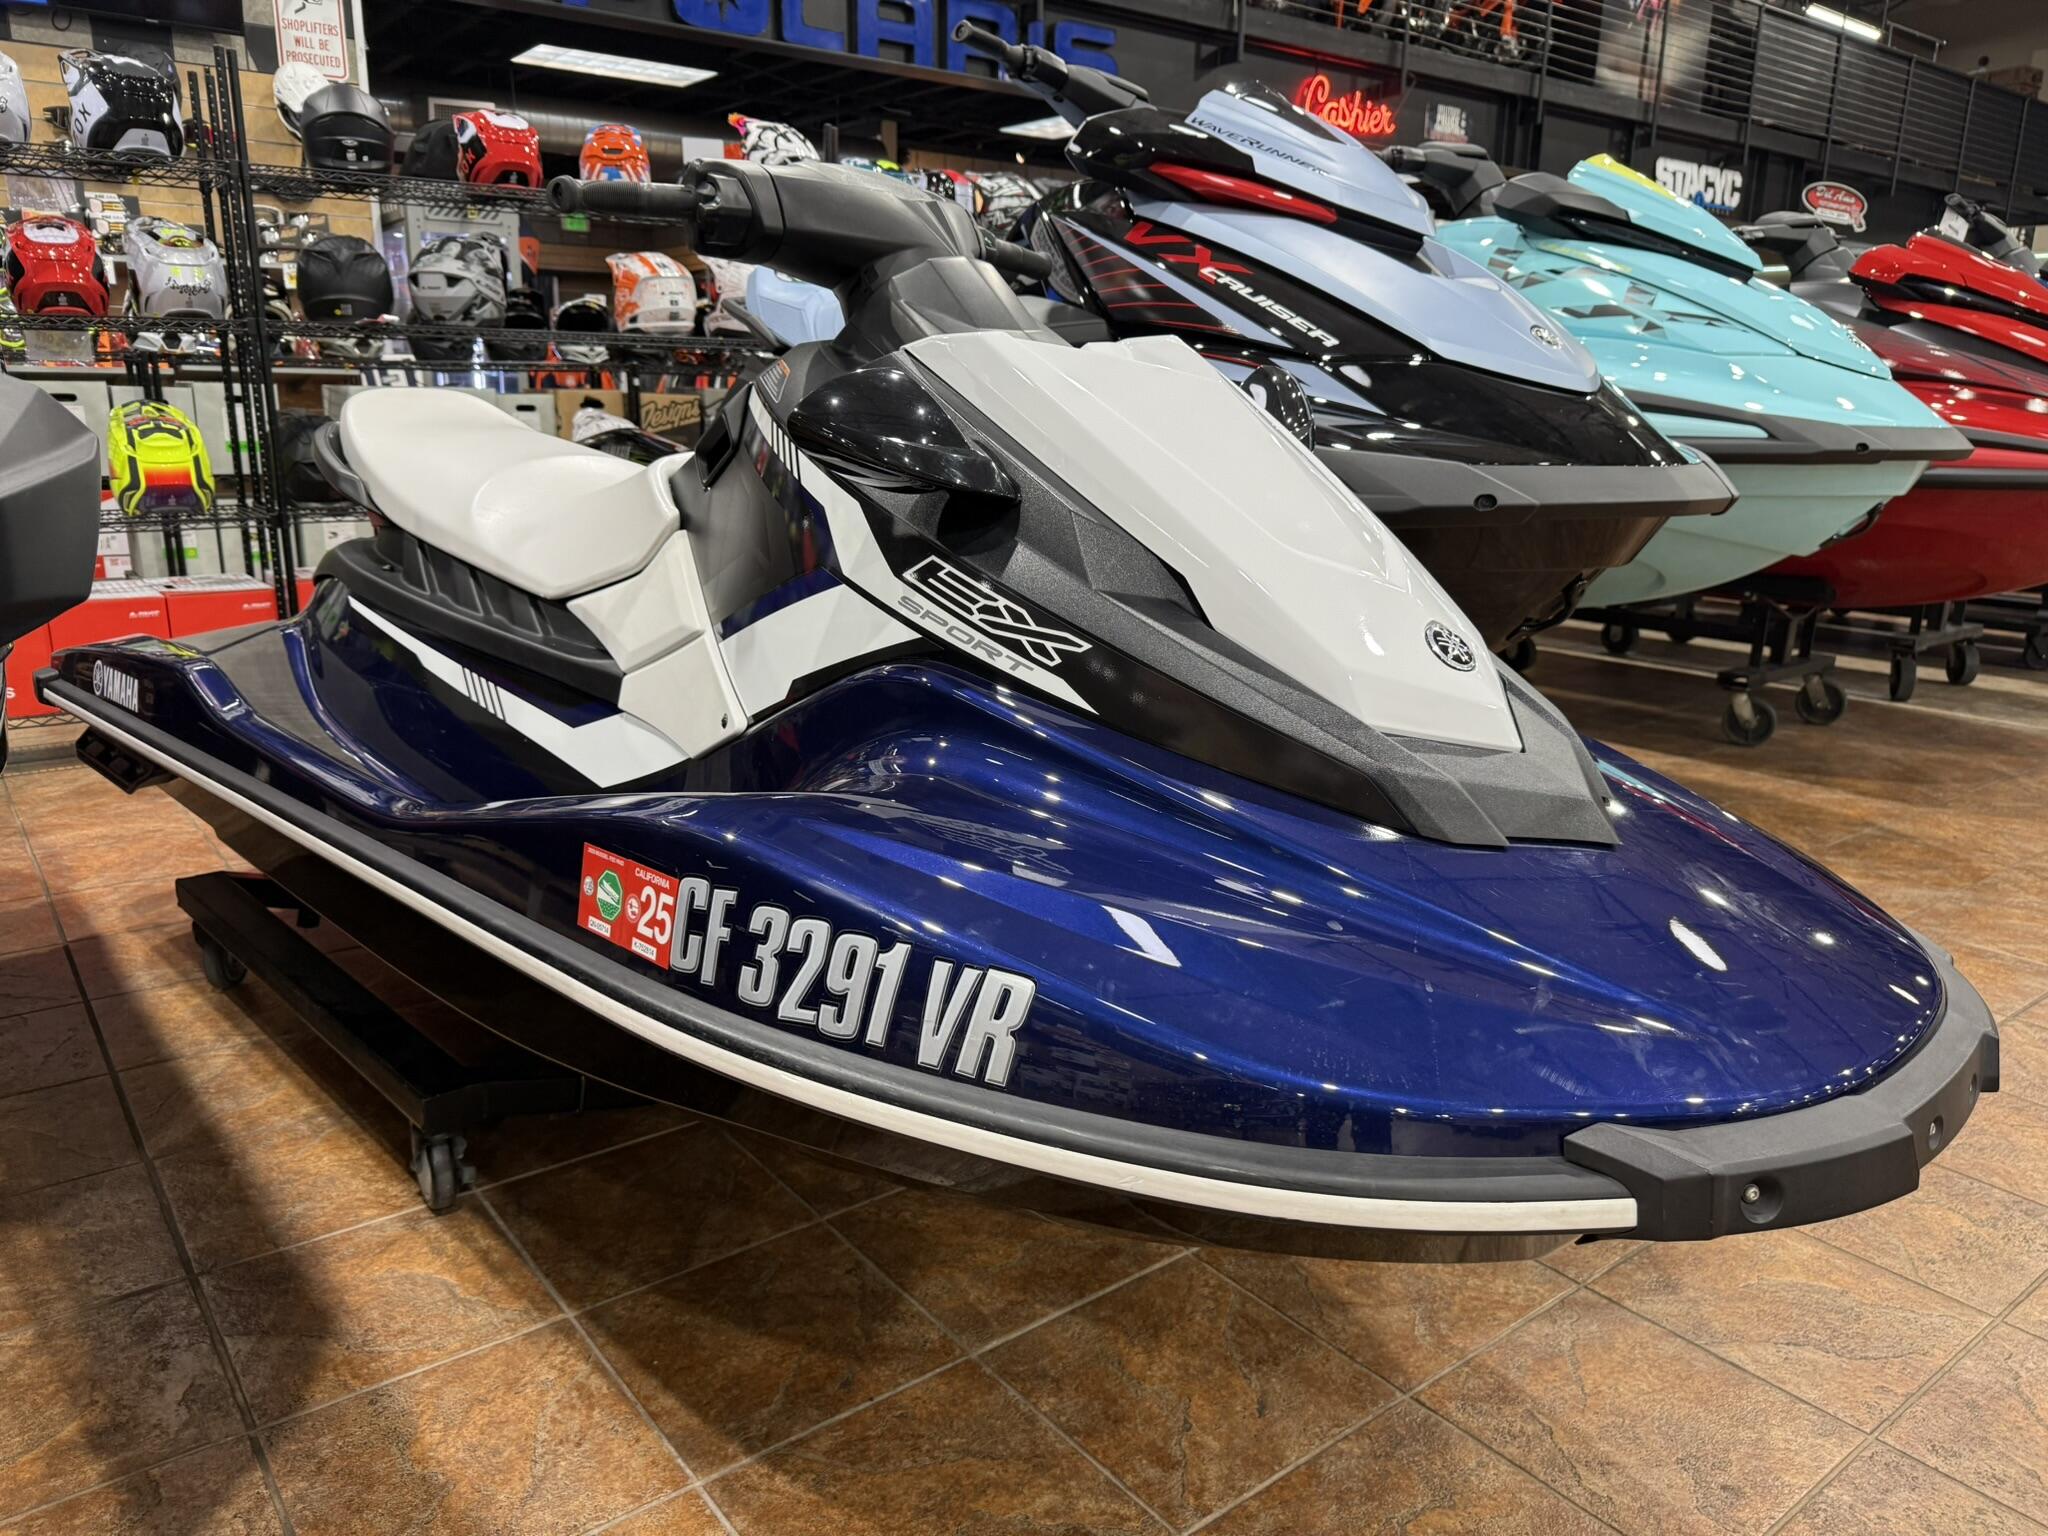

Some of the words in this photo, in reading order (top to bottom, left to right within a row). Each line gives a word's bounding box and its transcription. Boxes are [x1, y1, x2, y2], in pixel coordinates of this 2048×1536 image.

[281, 18, 339, 37] SHOPLIFTERS
[293, 35, 315, 49] WILL
[318, 39, 331, 51] BE
[285, 50, 342, 69] PROSECUTED
[1303, 73, 1396, 135] Cashier
[1190, 116, 1332, 177] WAVERUNNER
[1655, 156, 1744, 209] STACYC
[1124, 221, 1254, 285] VX
[1200, 266, 1341, 348] CRUISER
[640, 398, 701, 429] Designs
[897, 595, 1035, 673] SPORT
[103, 665, 139, 713] YAMAHA
[635, 867, 670, 889] CALIFORNIA
[637, 885, 674, 945] 25
[670, 875, 739, 986] CF
[737, 904, 912, 1048] 3291
[917, 956, 1038, 1088] VR
